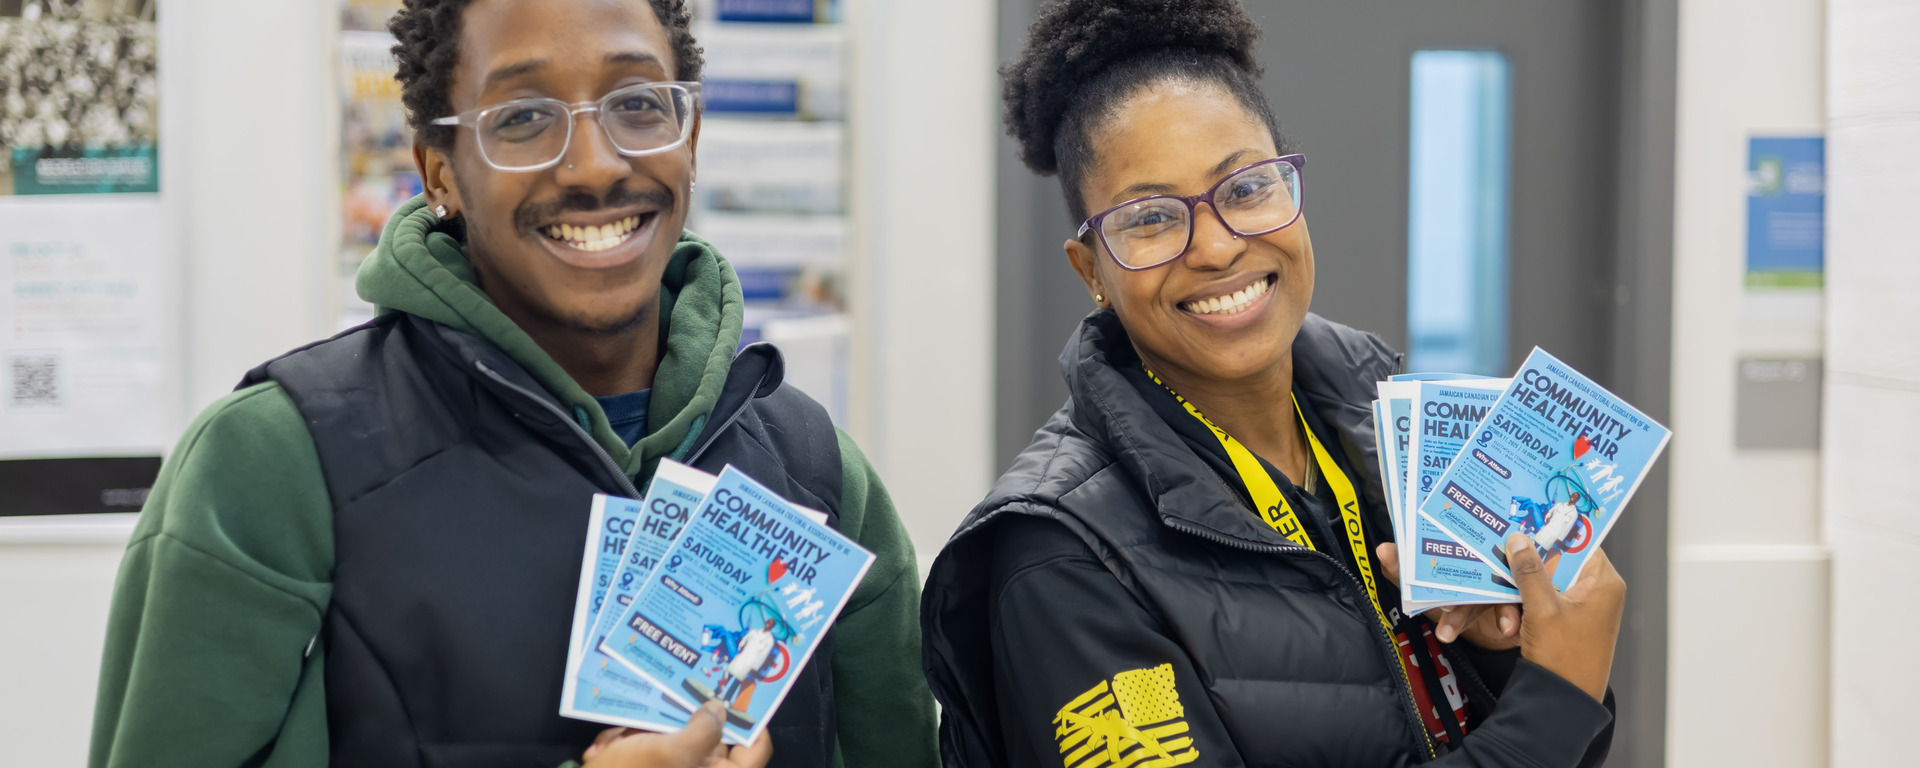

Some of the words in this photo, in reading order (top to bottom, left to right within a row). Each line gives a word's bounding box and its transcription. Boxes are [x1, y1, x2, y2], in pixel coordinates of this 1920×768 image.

[1439, 390, 1463, 398] JAMAICAN
[1464, 392, 1489, 400] CANADIAN
[1524, 369, 1631, 440] COMMUNITY
[1546, 363, 1569, 380] JAMAICAN
[1567, 376, 1590, 394] CANADIAN
[1589, 390, 1610, 407] CULTURAL
[1610, 403, 1638, 424] ASSOCIATION
[1642, 424, 1650, 432] BC
[1493, 414, 1558, 459] SATURDAY
[1476, 450, 1489, 463] Why
[1487, 460, 1508, 477] Attend:
[714, 488, 830, 564] COMMUNITY
[1447, 486, 1473, 509] FREE
[1472, 505, 1505, 531] EVENT
[683, 537, 752, 584] SATURDAY
[1426, 542, 1452, 555] FREE
[1455, 546, 1477, 558] EVE
[632, 617, 662, 641] FREE
[660, 635, 697, 663] EVENT
